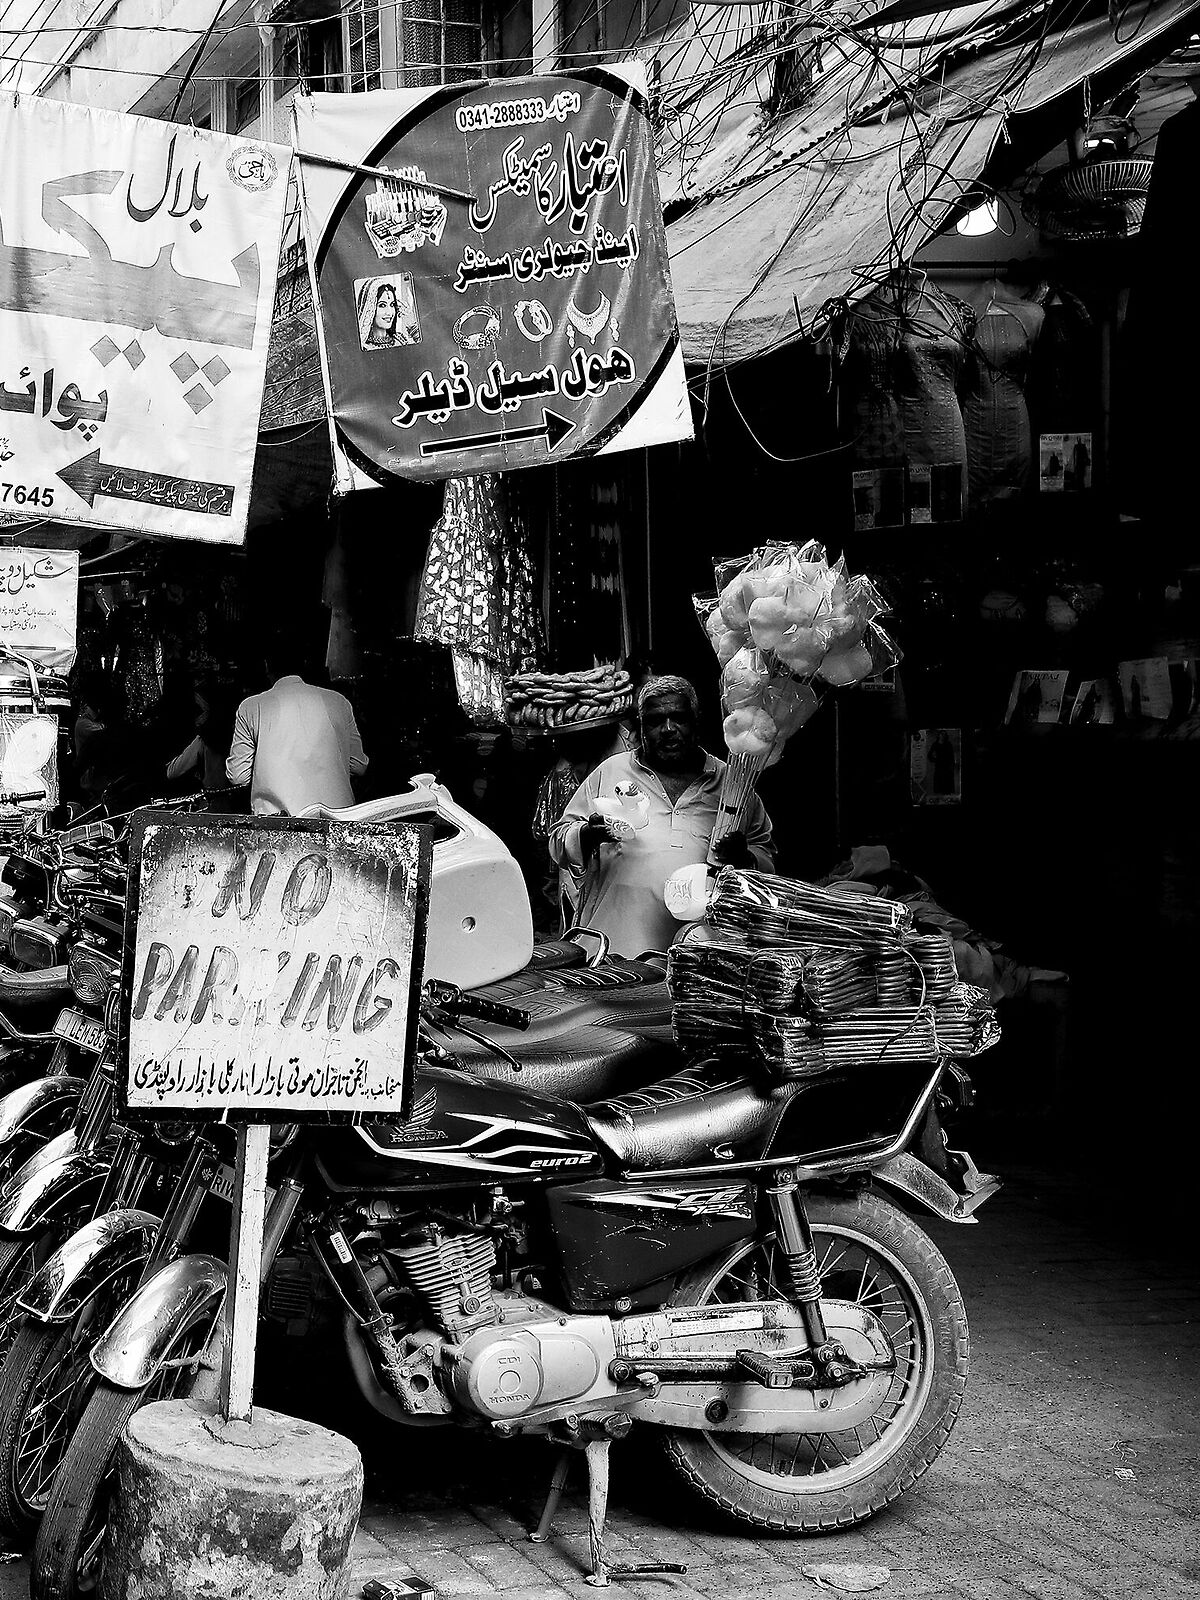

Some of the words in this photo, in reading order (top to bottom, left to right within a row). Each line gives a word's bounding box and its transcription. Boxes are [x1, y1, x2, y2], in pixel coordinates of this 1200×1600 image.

[458, 100, 545, 129] 0341-2888333
[127, 133, 209, 233] بلال
[514, 237, 593, 282] جیولری
[595, 222, 639, 269] اینڈ
[392, 356, 475, 428] ڈیلر
[476, 360, 559, 414] سیل
[8, 556, 73, 595] شکیل
[211, 850, 332, 926] NO
[132, 942, 401, 1034] PARING
[287, 1057, 313, 1095] موتی
[390, 1130, 449, 1143] HONDA
[530, 1153, 593, 1168] euro2
[497, 1356, 521, 1365] CDI
[489, 1393, 531, 1404] HONDA
